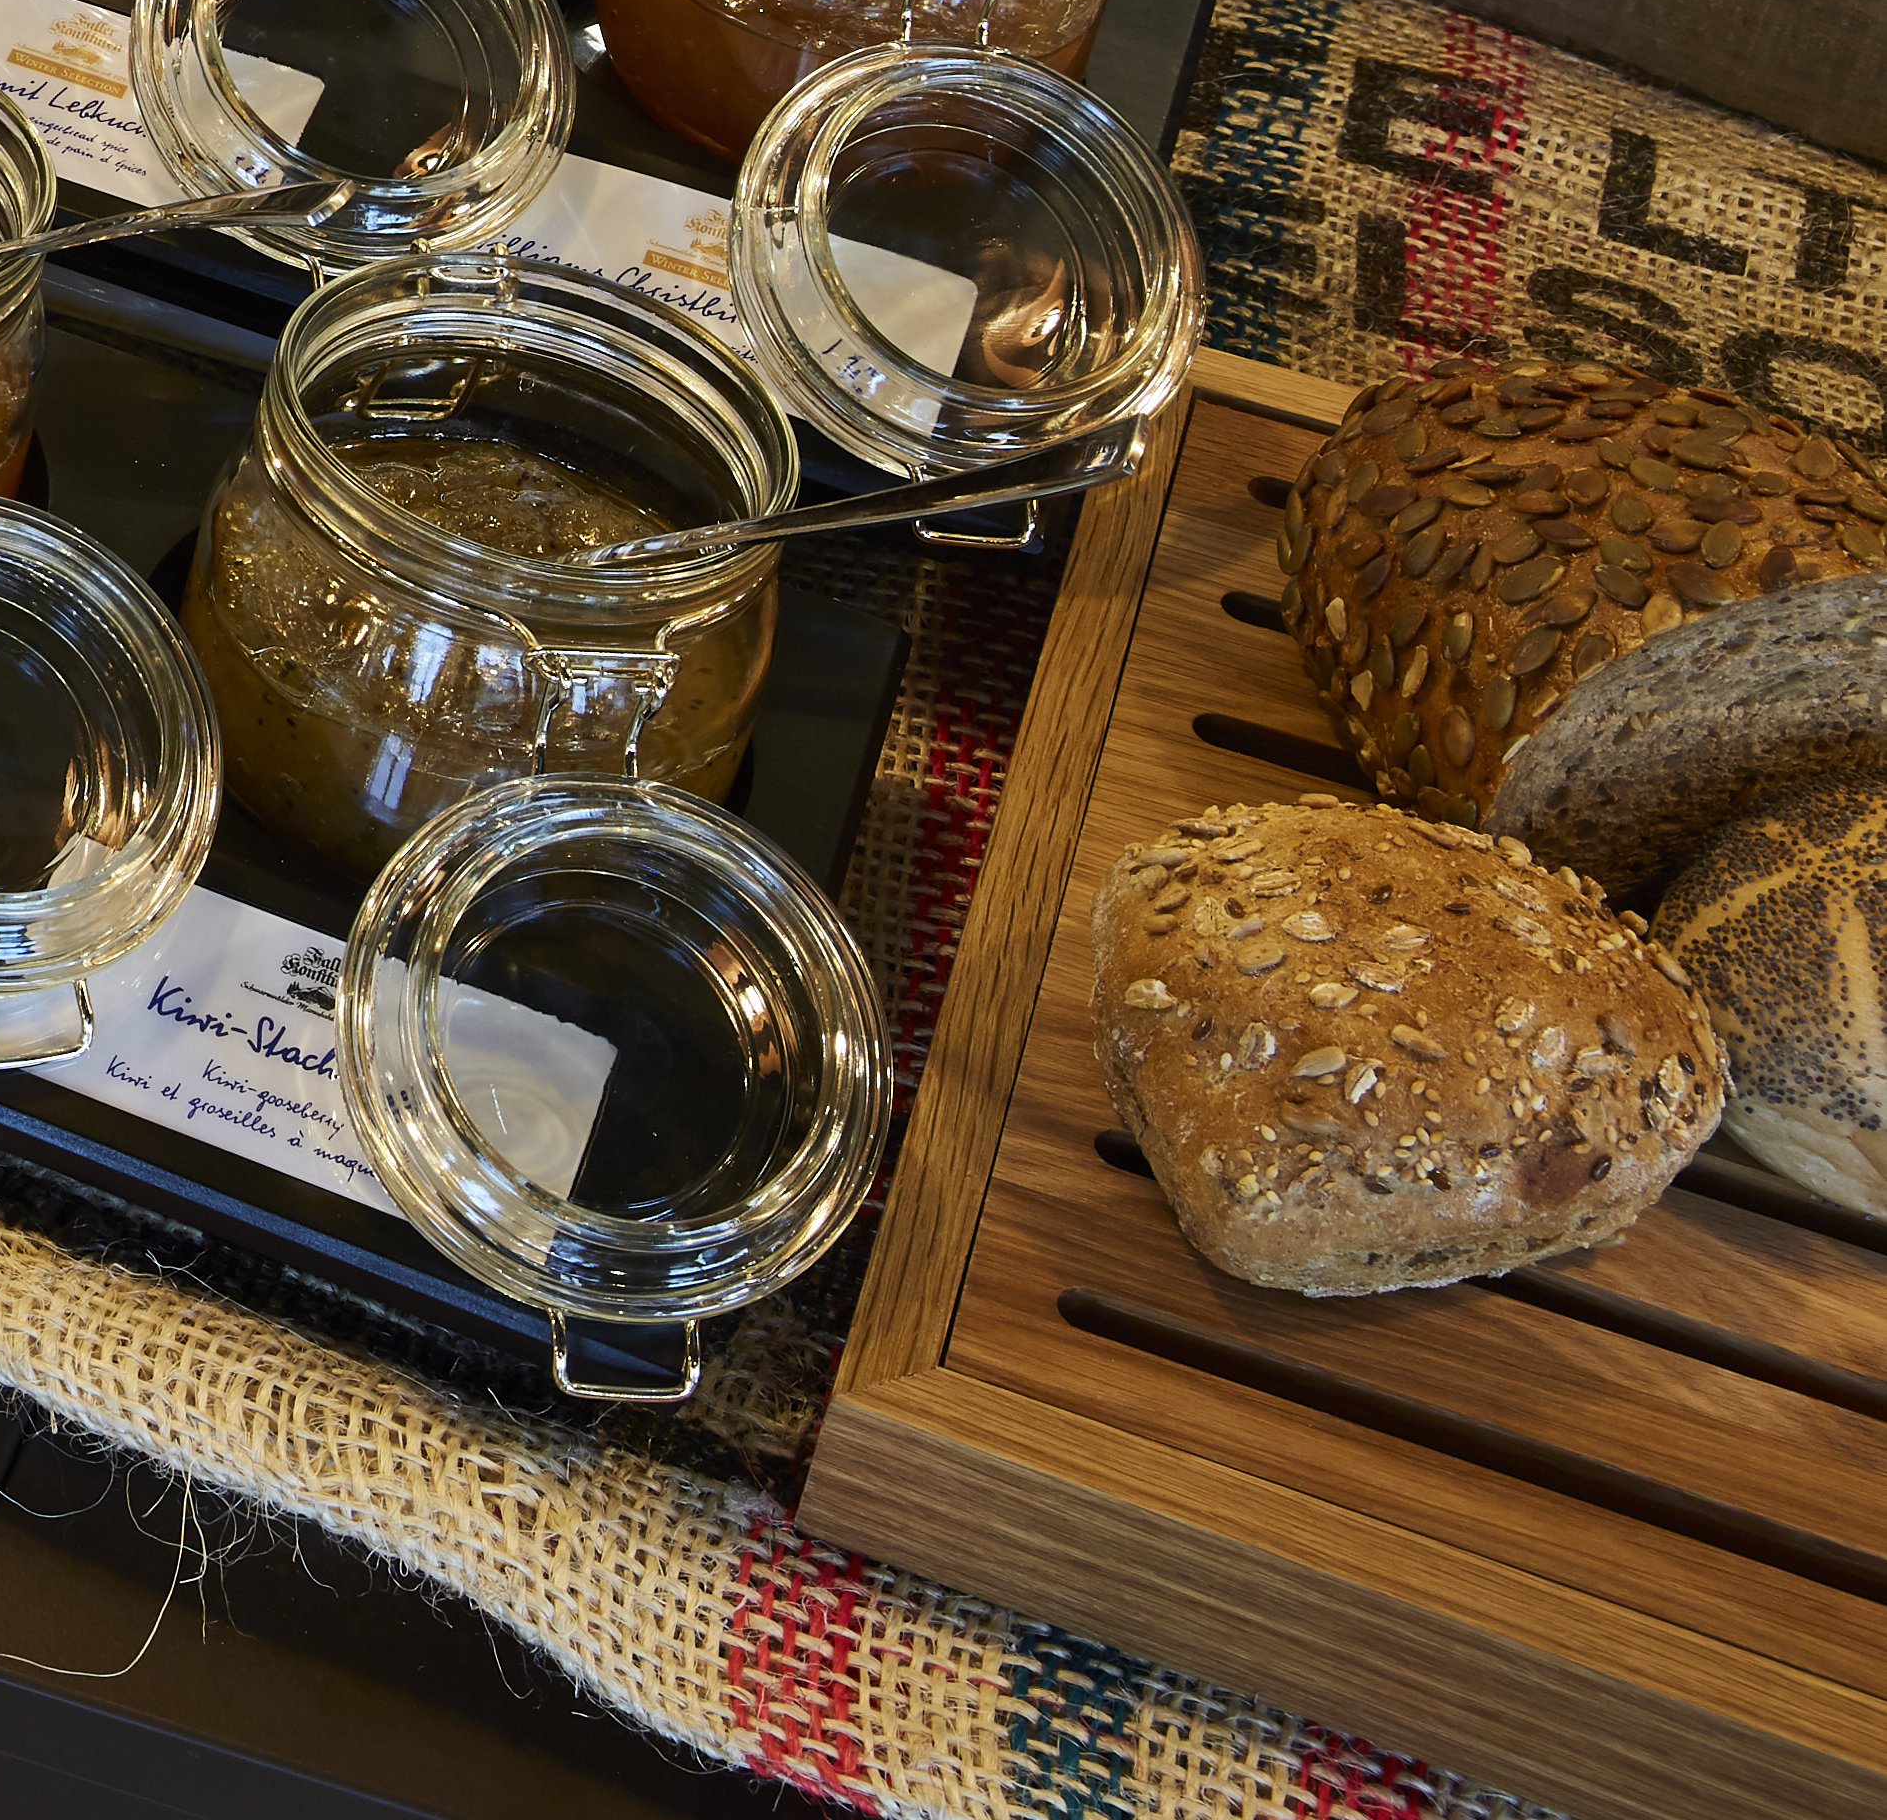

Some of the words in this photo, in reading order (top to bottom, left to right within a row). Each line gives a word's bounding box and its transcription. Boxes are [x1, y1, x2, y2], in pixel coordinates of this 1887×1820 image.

[13, 51, 59, 74] WINTER
[60, 67, 121, 95] SELECTION
[650, 252, 699, 278] WINTER
[303, 946, 342, 973] Fall
[104, 1054, 151, 1090] Kiwi
[160, 1082, 181, 1100] et
[188, 1095, 277, 1140] groseilles
[201, 1058, 345, 1141] Kiwi-gooseberry
